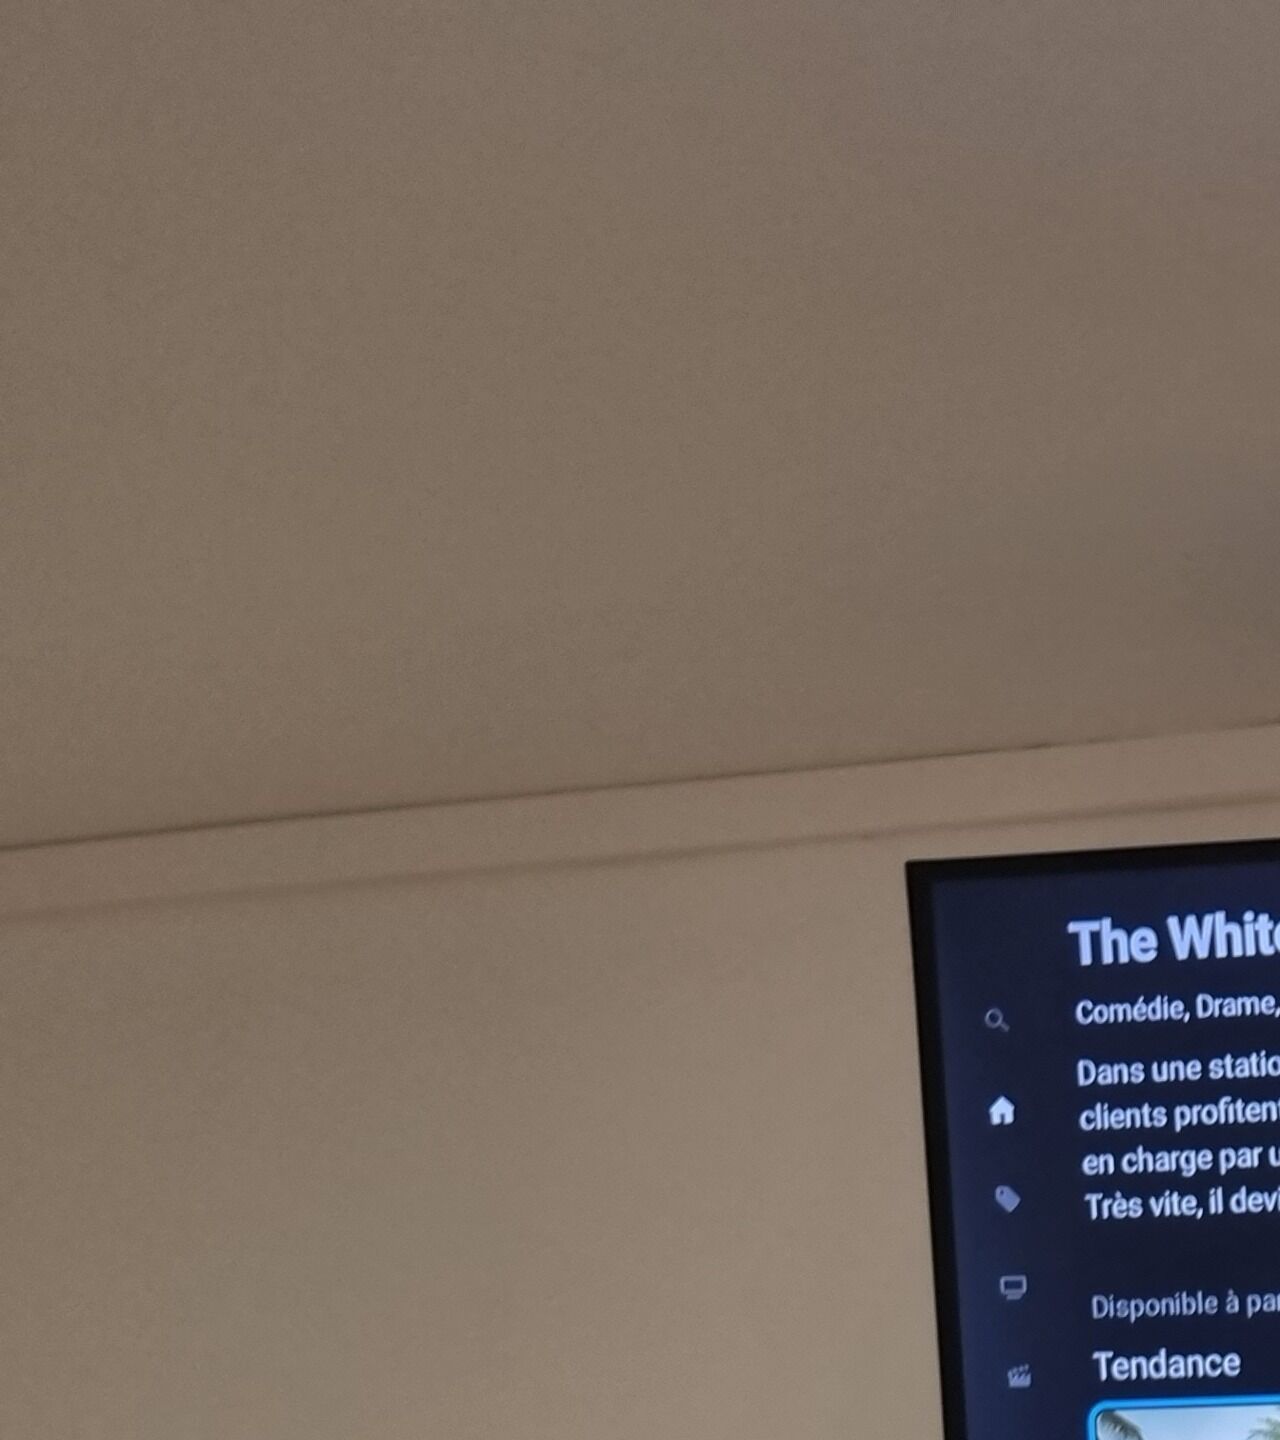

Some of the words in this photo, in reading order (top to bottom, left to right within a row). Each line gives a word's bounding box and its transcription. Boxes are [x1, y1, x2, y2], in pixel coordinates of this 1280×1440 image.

[1067, 917, 1158, 966] The
[1075, 994, 1190, 1025] Comédie,
[1195, 991, 1280, 1019] Drame,
[1077, 1059, 1145, 1086] Dans
[1151, 1058, 1202, 1083] une
[1079, 1101, 1167, 1131] clients
[1082, 1155, 1114, 1176] en
[1121, 1145, 1213, 1177] charge
[1219, 1146, 1261, 1175] par
[1085, 1192, 1142, 1221] Très
[1149, 1191, 1203, 1219] vite,
[1209, 1186, 1223, 1215] il
[1091, 1290, 1217, 1322] Disponible
[1226, 1289, 1239, 1313] à
[1092, 1348, 1241, 1382] Tendance
